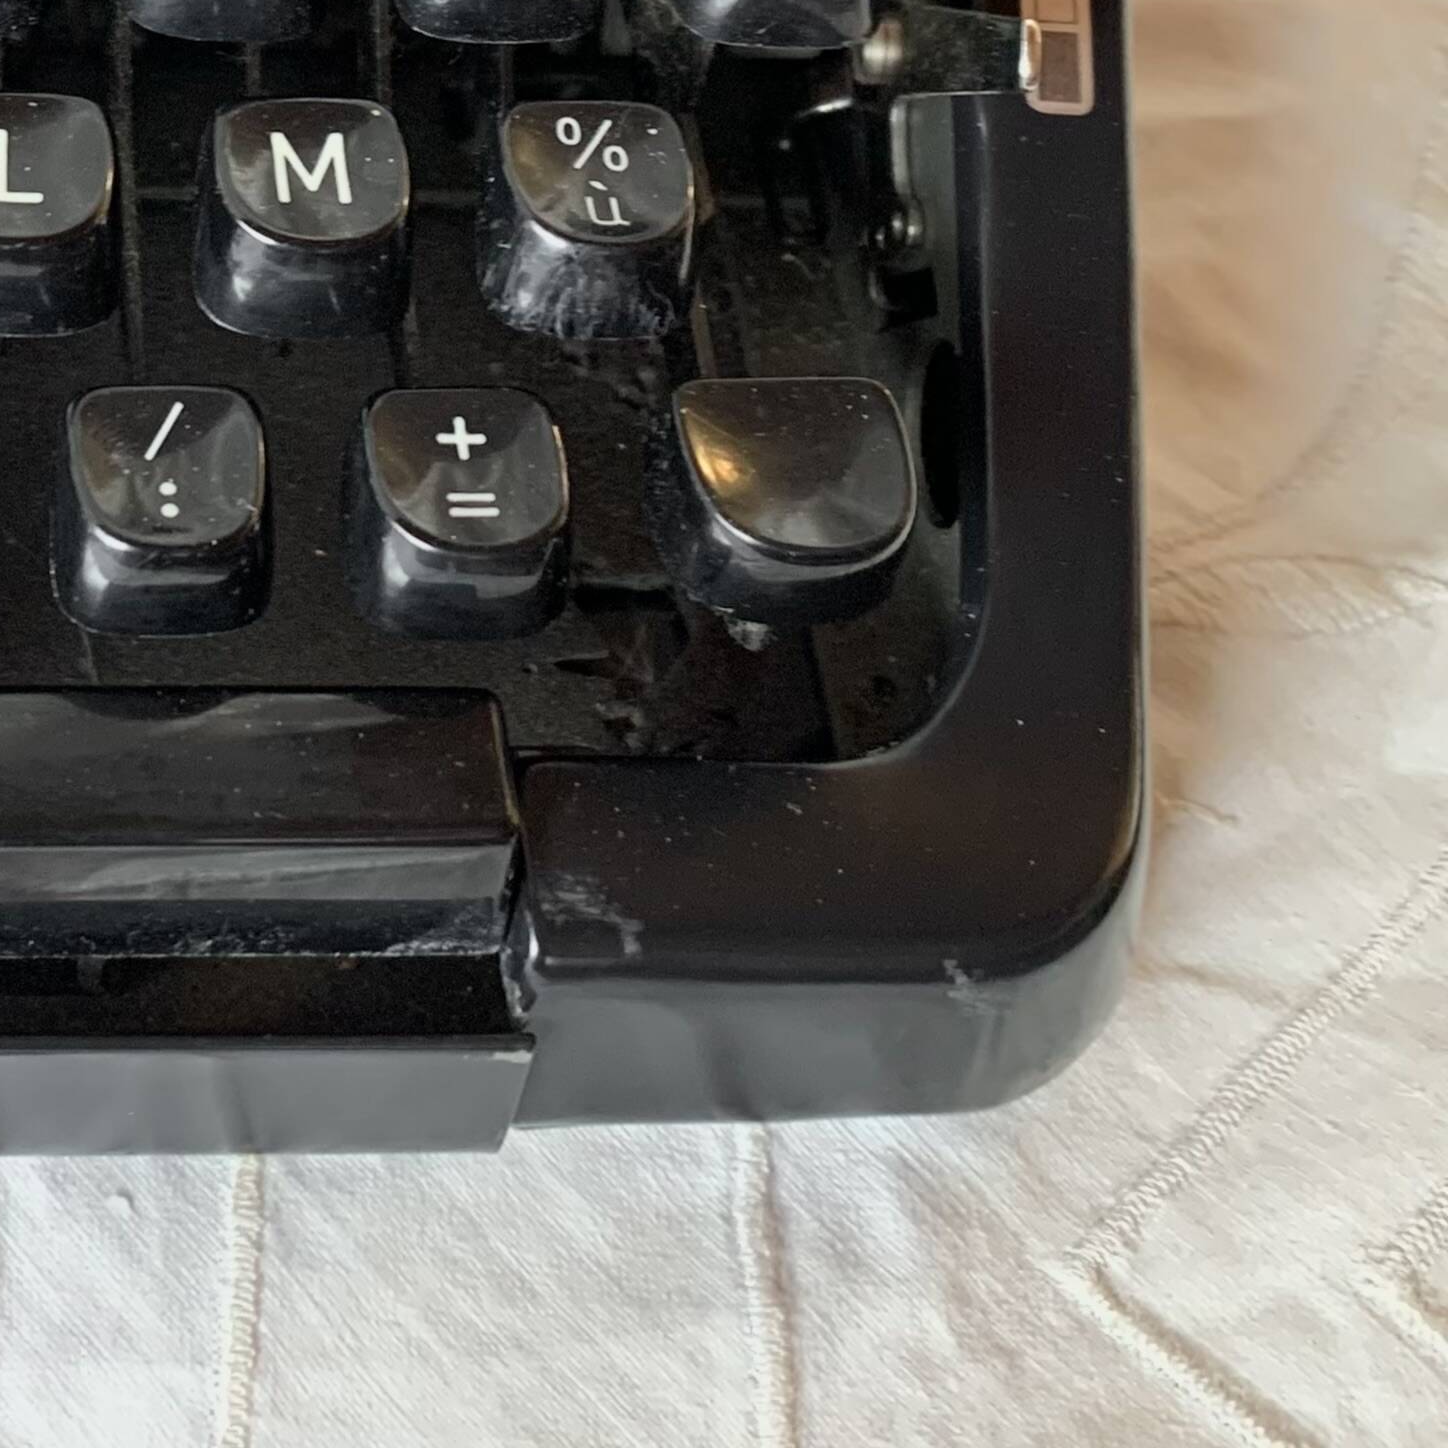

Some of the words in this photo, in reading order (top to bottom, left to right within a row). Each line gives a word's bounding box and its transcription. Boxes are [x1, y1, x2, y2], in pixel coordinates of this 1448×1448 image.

[270, 132, 353, 204] M
[556, 116, 629, 172] %
[585, 180, 630, 226] ù
[144, 401, 184, 461] /
[436, 416, 487, 461] +
[446, 492, 500, 517] =
